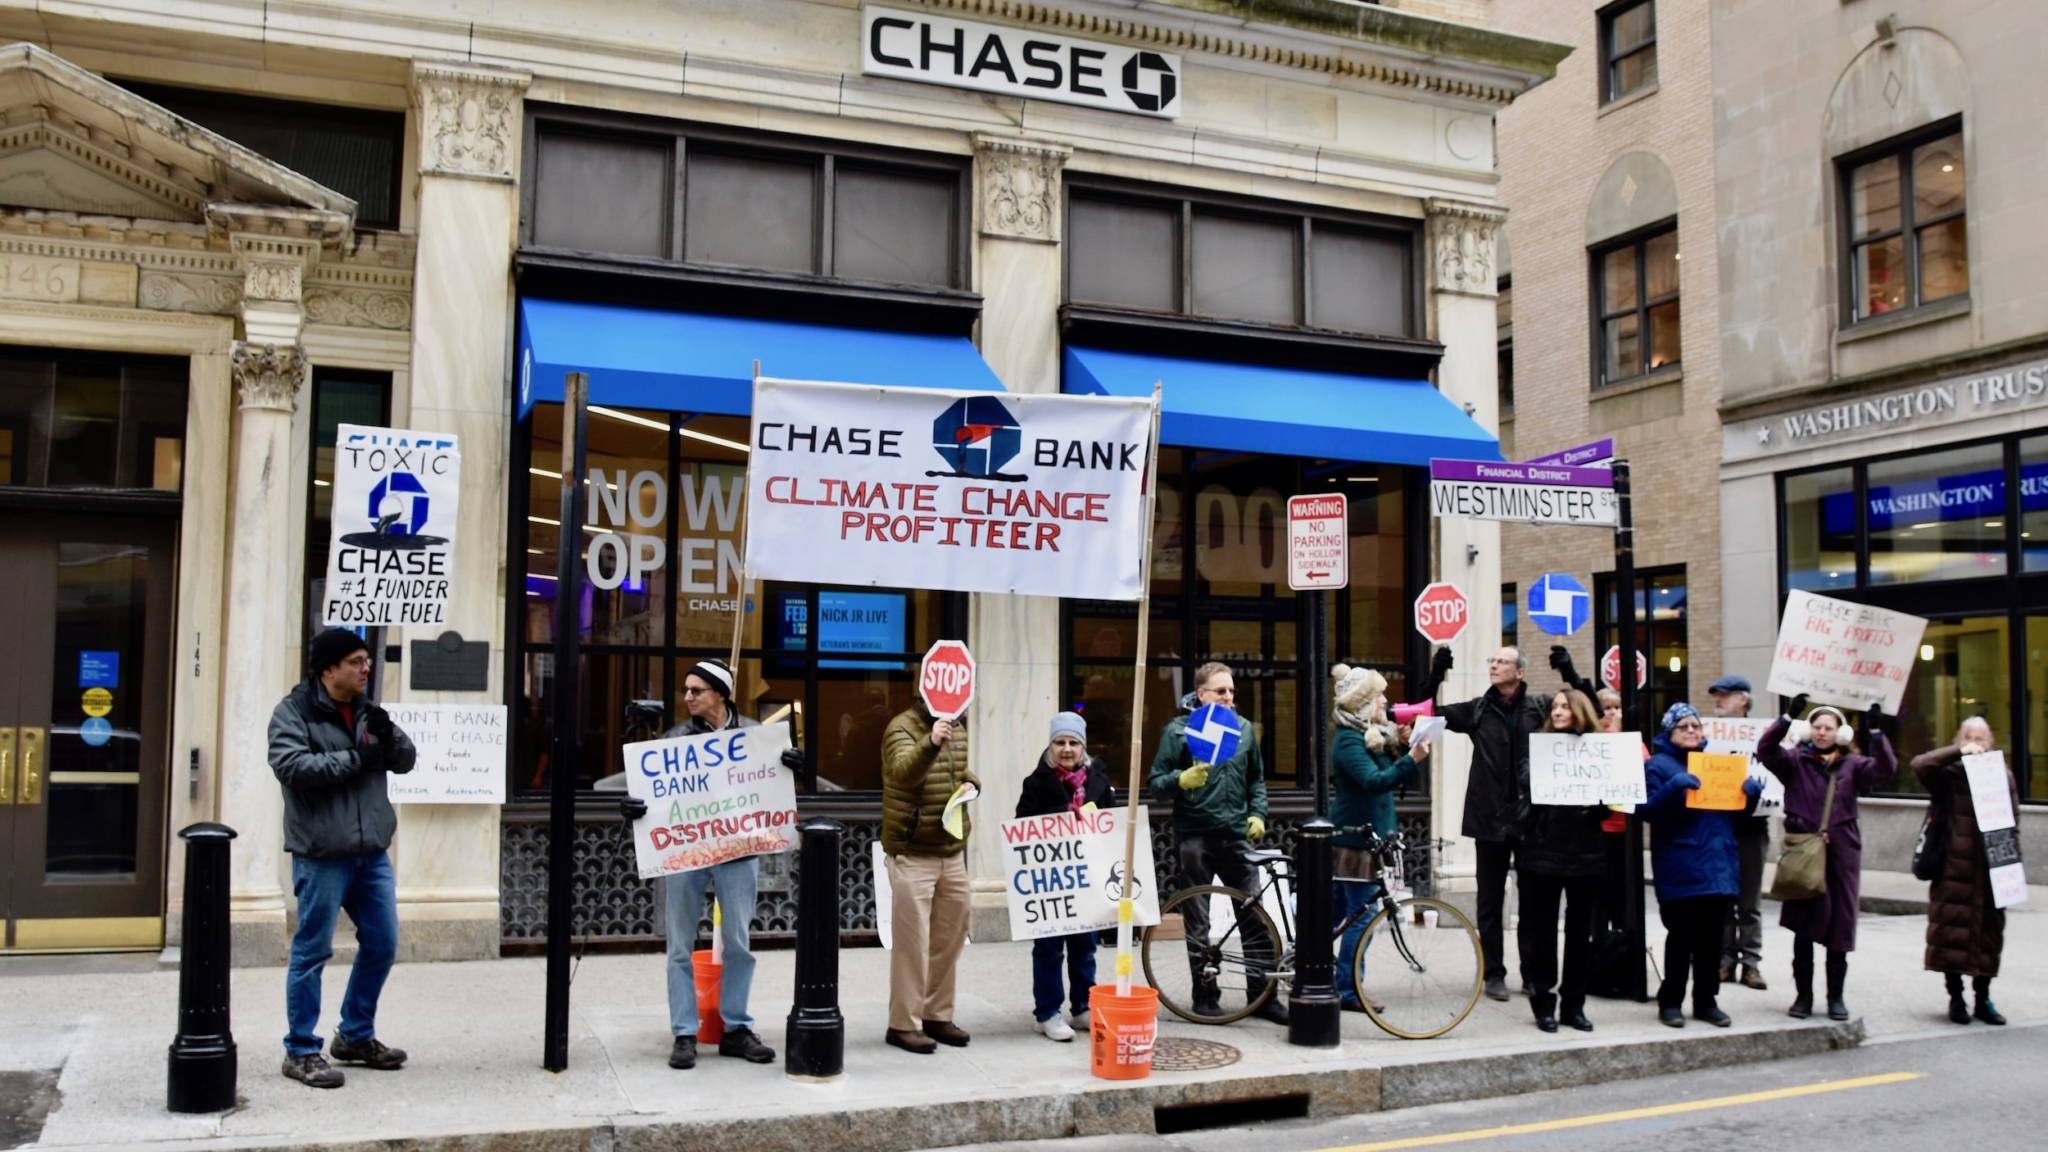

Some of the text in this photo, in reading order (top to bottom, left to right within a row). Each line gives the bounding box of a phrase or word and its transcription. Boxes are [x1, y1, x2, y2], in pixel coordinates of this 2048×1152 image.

[871, 17, 1107, 97] CHASE
[1784, 364, 2048, 439] WASHINGTON TRUS
[345, 447, 449, 475] TOXIC
[758, 422, 1139, 472] CHASE BANK
[588, 467, 744, 532] NOW
[765, 475, 1111, 523] CLIMATE CHANGE
[1292, 500, 1342, 518] WARNING
[1434, 484, 1596, 520] WESTMINSTER
[1870, 483, 1994, 516] WASHINGTON
[840, 511, 1061, 552] PROFITEER
[1294, 534, 1342, 547] PARKING
[1309, 520, 1326, 533] NO
[338, 549, 446, 576] CHASE
[587, 533, 756, 595] OPEN
[1294, 549, 1342, 559] ON HOLLOW
[1297, 559, 1338, 569] SIDEWALK
[340, 577, 449, 600] #1 FUNDER
[328, 600, 444, 624] FOSSIL FUEL
[785, 605, 807, 622] FEB
[821, 608, 889, 625] NICK JR LIVE
[1419, 599, 1466, 627] STOP
[1806, 598, 1853, 622] CHASE
[1780, 640, 1827, 668] DEATH
[925, 661, 971, 695] STOP
[455, 711, 502, 727] BANK
[412, 731, 504, 746] ITH CHASE
[1552, 741, 1613, 760] CHASE
[641, 732, 748, 777] CHASE
[653, 763, 777, 798] BANK Funds
[1552, 762, 1612, 780] FUNDS
[668, 792, 760, 824] Amazon
[1001, 811, 1114, 843] WARNING
[1013, 840, 1085, 865] TOXIC
[1013, 864, 1091, 896] CHASE
[1024, 895, 1078, 923] SITE
